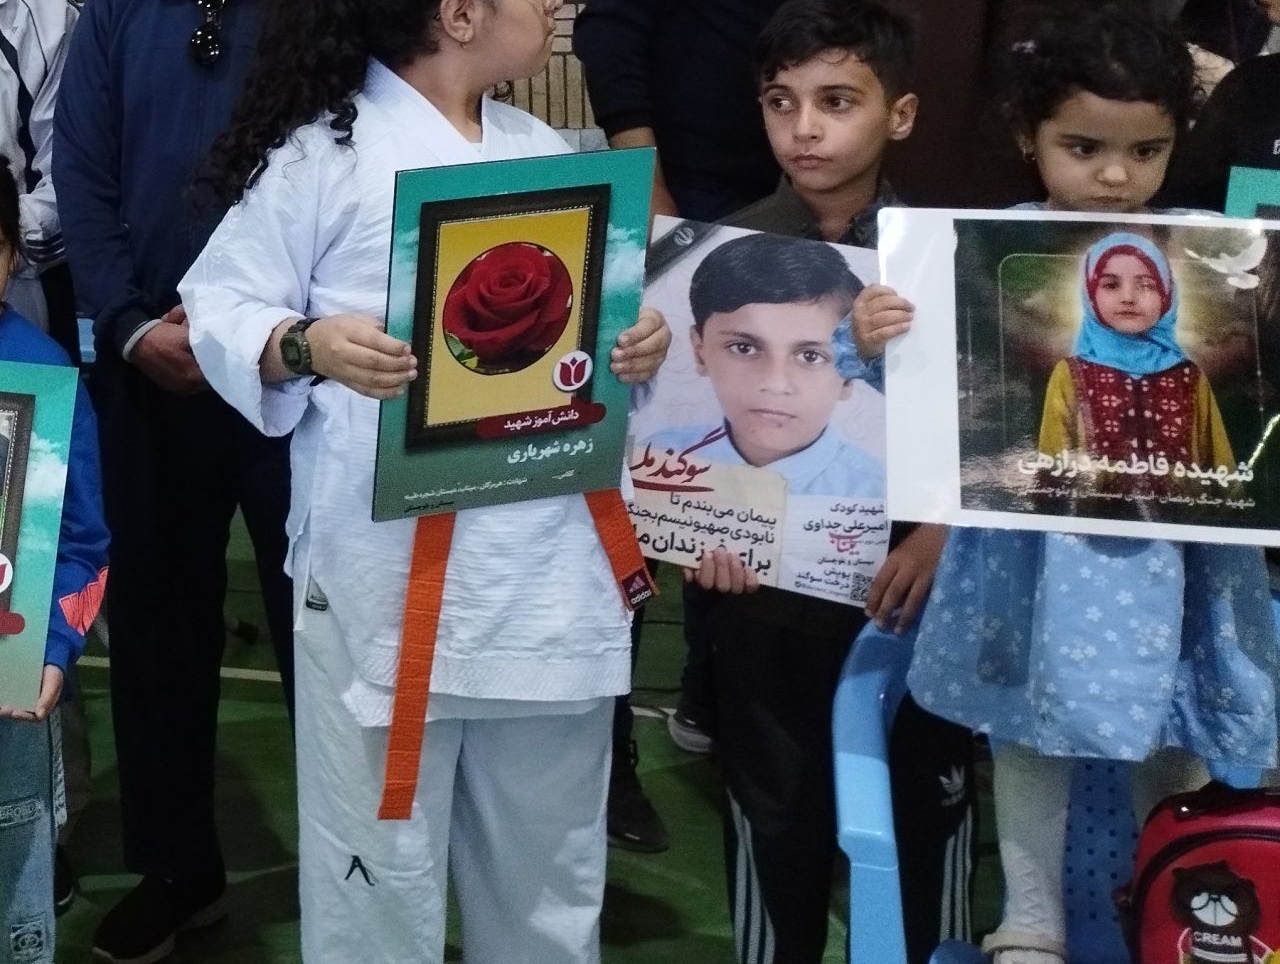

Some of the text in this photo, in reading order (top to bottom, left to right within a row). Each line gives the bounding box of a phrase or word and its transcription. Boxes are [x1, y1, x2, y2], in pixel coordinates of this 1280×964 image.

[504, 415, 532, 431] شهید
[507, 437, 594, 464] زهره شهریاری
[1098, 451, 1170, 477] فاطمه
[1174, 461, 1254, 488] شهیده
[670, 492, 680, 506] تا
[1196, 495, 1223, 506] جنگ
[1226, 495, 1256, 509] شهید
[859, 504, 885, 516] شهید
[658, 513, 730, 535] صهیونیسم
[737, 508, 777, 531] پیمان
[803, 518, 889, 533] امیرعلی جداوی
[730, 526, 775, 545] نابودی
[630, 588, 652, 605] adidas
[1193, 931, 1243, 948] CREAM
